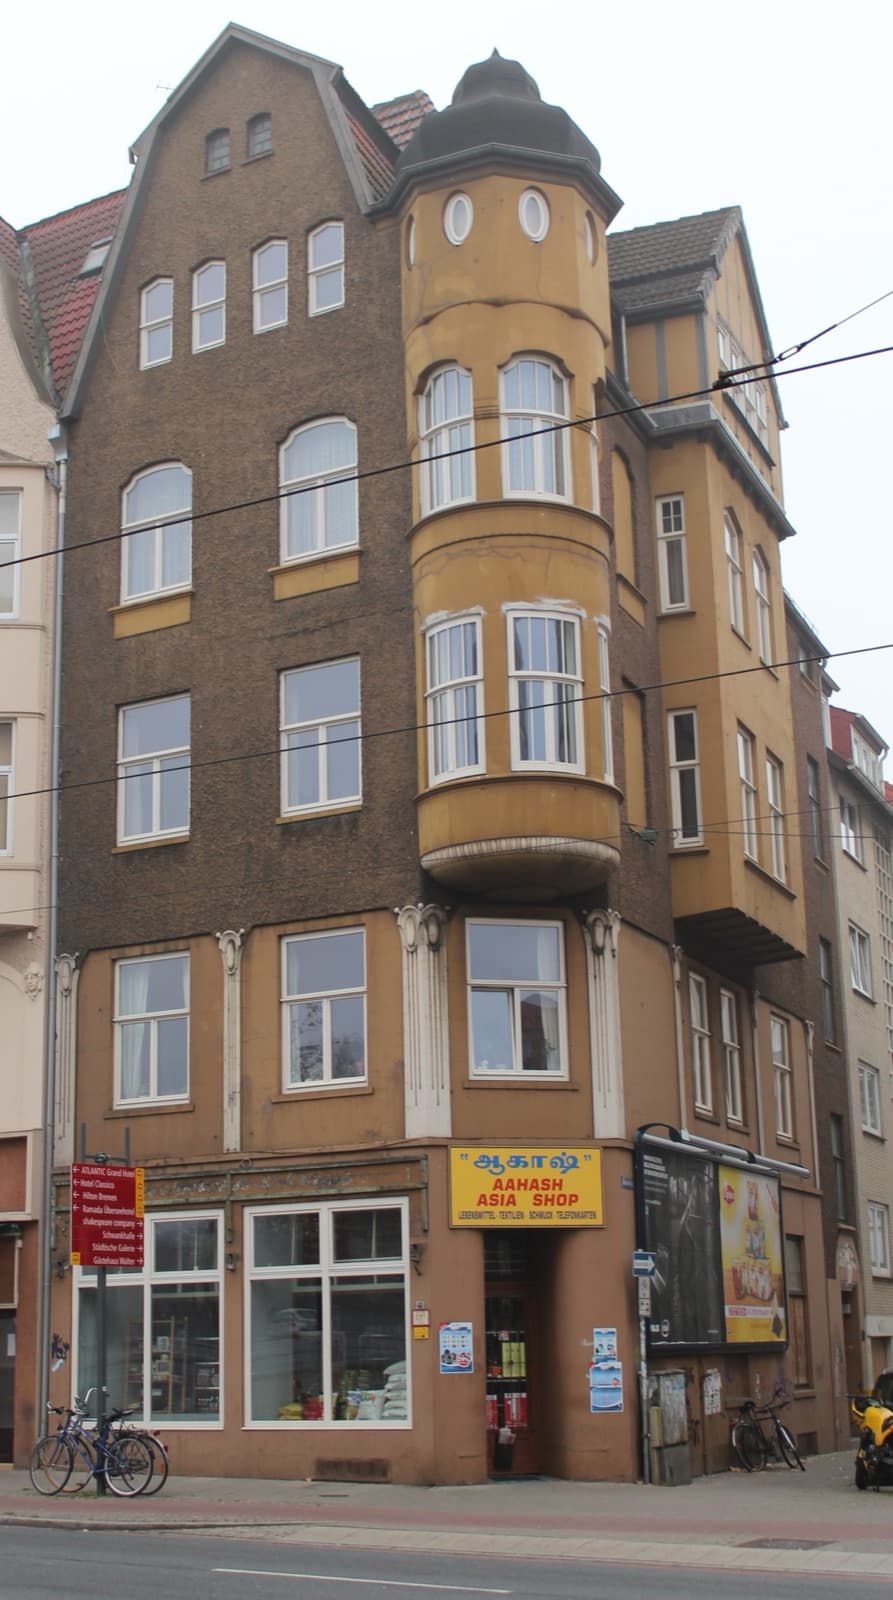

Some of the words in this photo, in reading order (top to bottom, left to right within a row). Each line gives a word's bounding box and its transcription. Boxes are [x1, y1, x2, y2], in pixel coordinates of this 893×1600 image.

[81, 1166, 106, 1176] ATLANTIC
[107, 1168, 122, 1176] Grand
[123, 1169, 135, 1178] Hotel
[80, 1180, 94, 1188] Hotel
[492, 1178, 563, 1191] AAHASH
[83, 1192, 97, 1200] Hilton
[99, 1193, 117, 1201] Bremen
[476, 1193, 517, 1207] ASIA
[532, 1193, 579, 1207] SHOP
[83, 1205, 103, 1213] Ramada
[113, 1220, 135, 1229] company
[118, 1244, 135, 1252] Galerie
[93, 1256, 119, 1265] Gästehaus
